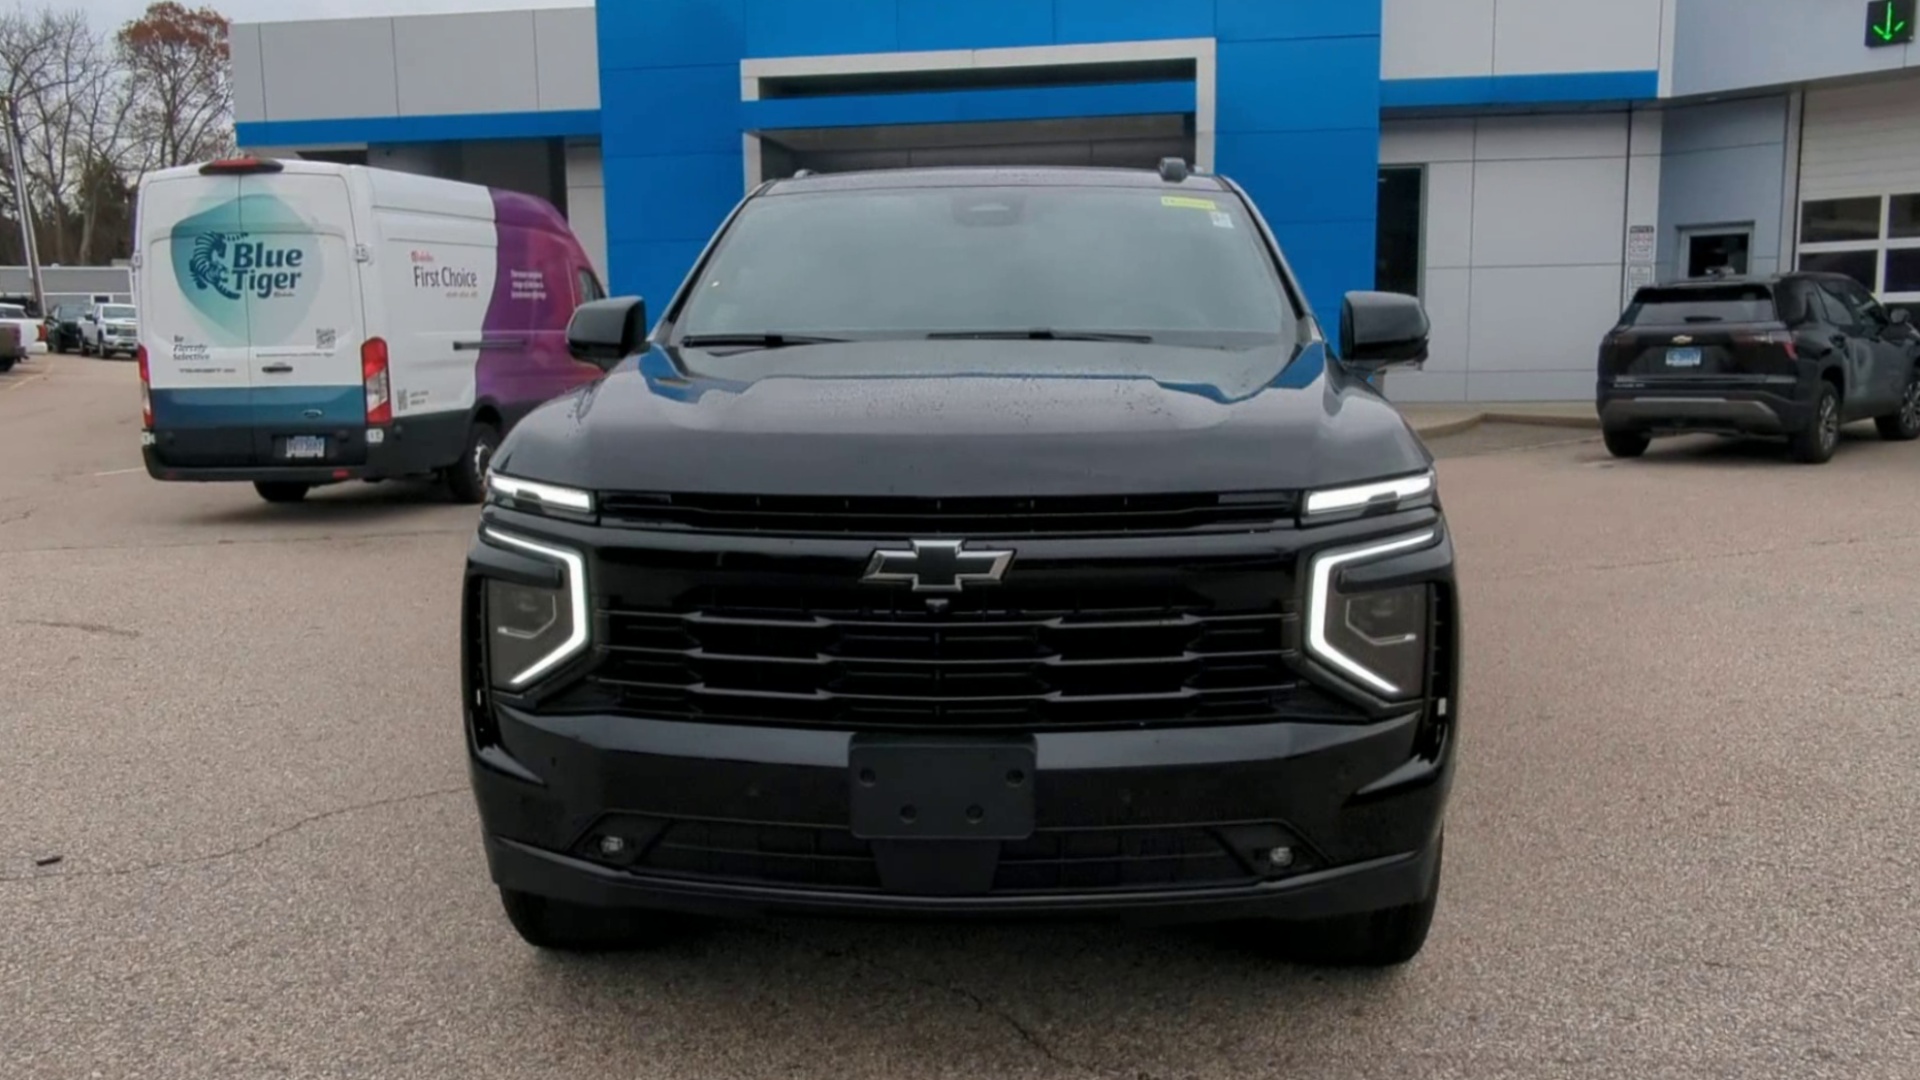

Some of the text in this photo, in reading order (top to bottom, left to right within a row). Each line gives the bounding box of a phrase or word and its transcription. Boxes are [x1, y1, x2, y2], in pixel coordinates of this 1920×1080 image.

[233, 242, 303, 268] Blue
[232, 269, 302, 299] Tiger
[414, 266, 478, 288] First Choice
